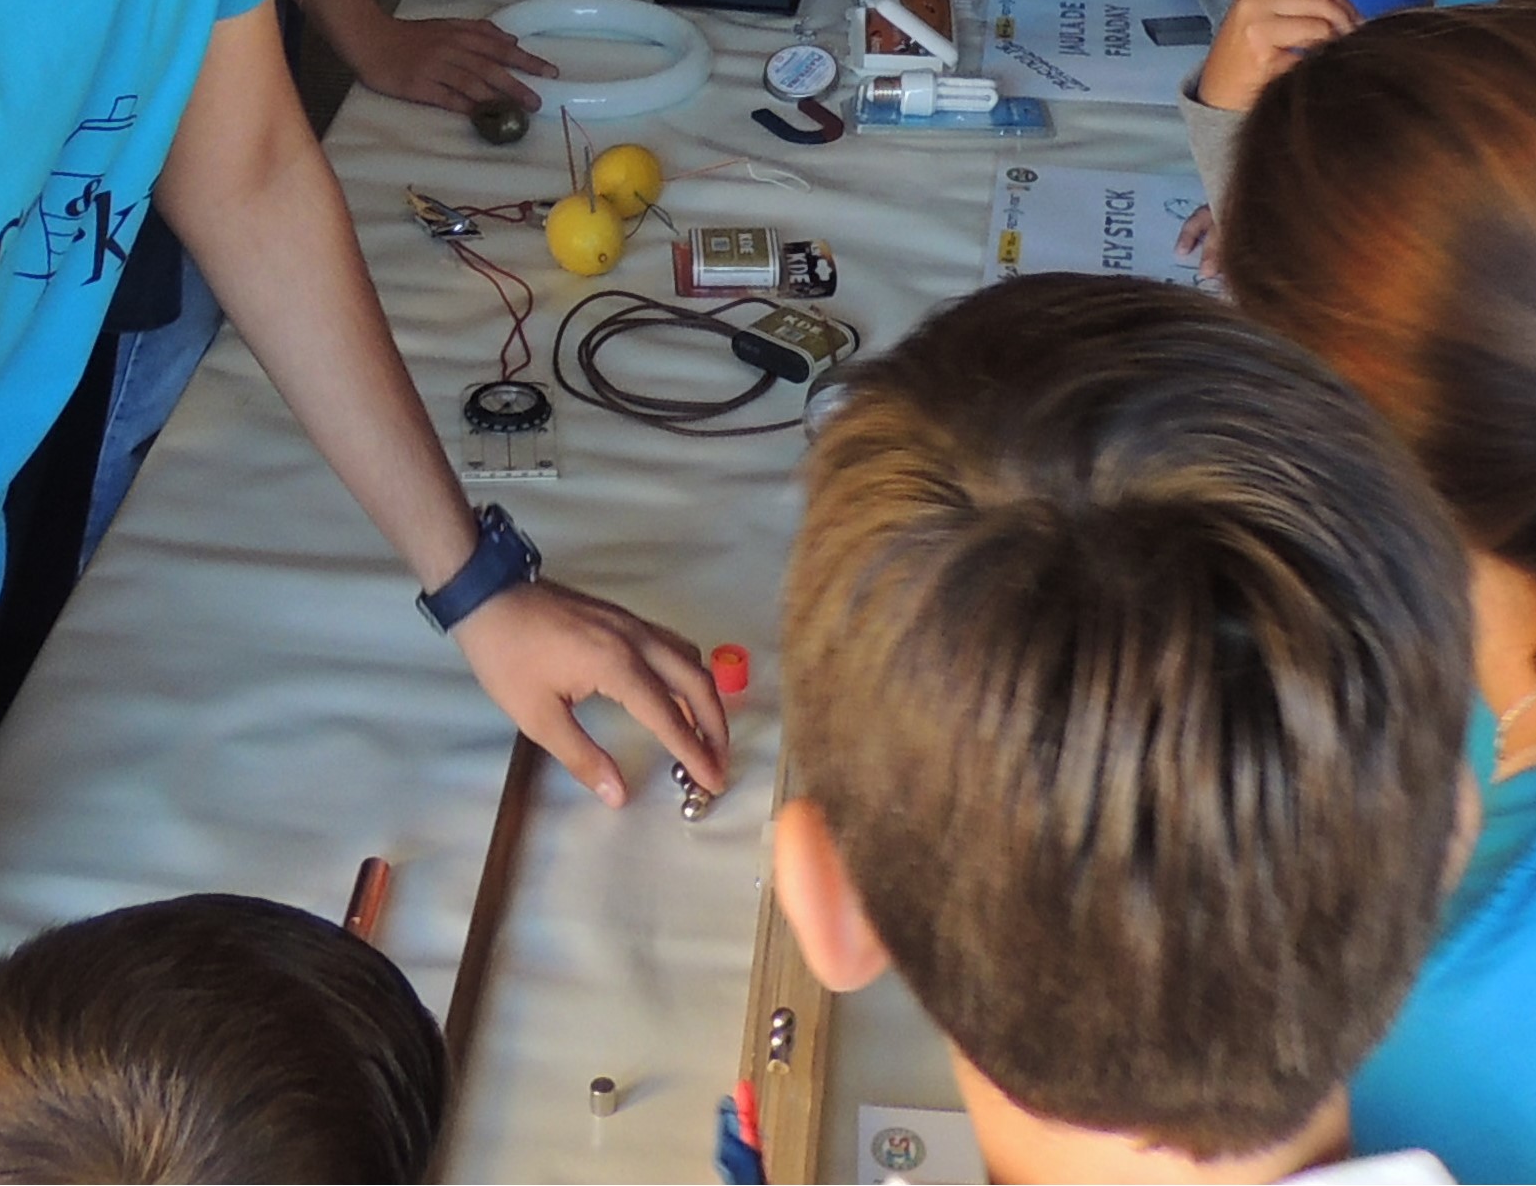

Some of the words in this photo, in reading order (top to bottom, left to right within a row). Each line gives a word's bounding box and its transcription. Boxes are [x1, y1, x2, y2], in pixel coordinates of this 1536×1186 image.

[1059, 0, 1087, 19] DE
[1058, 20, 1090, 57] JAULA
[1104, 3, 1132, 57] FARADAY
[1105, 188, 1135, 238] STICK
[737, 232, 755, 255] KDE
[1103, 239, 1134, 271] FLY
[786, 251, 811, 285] KDE
[782, 314, 824, 336] KDE
